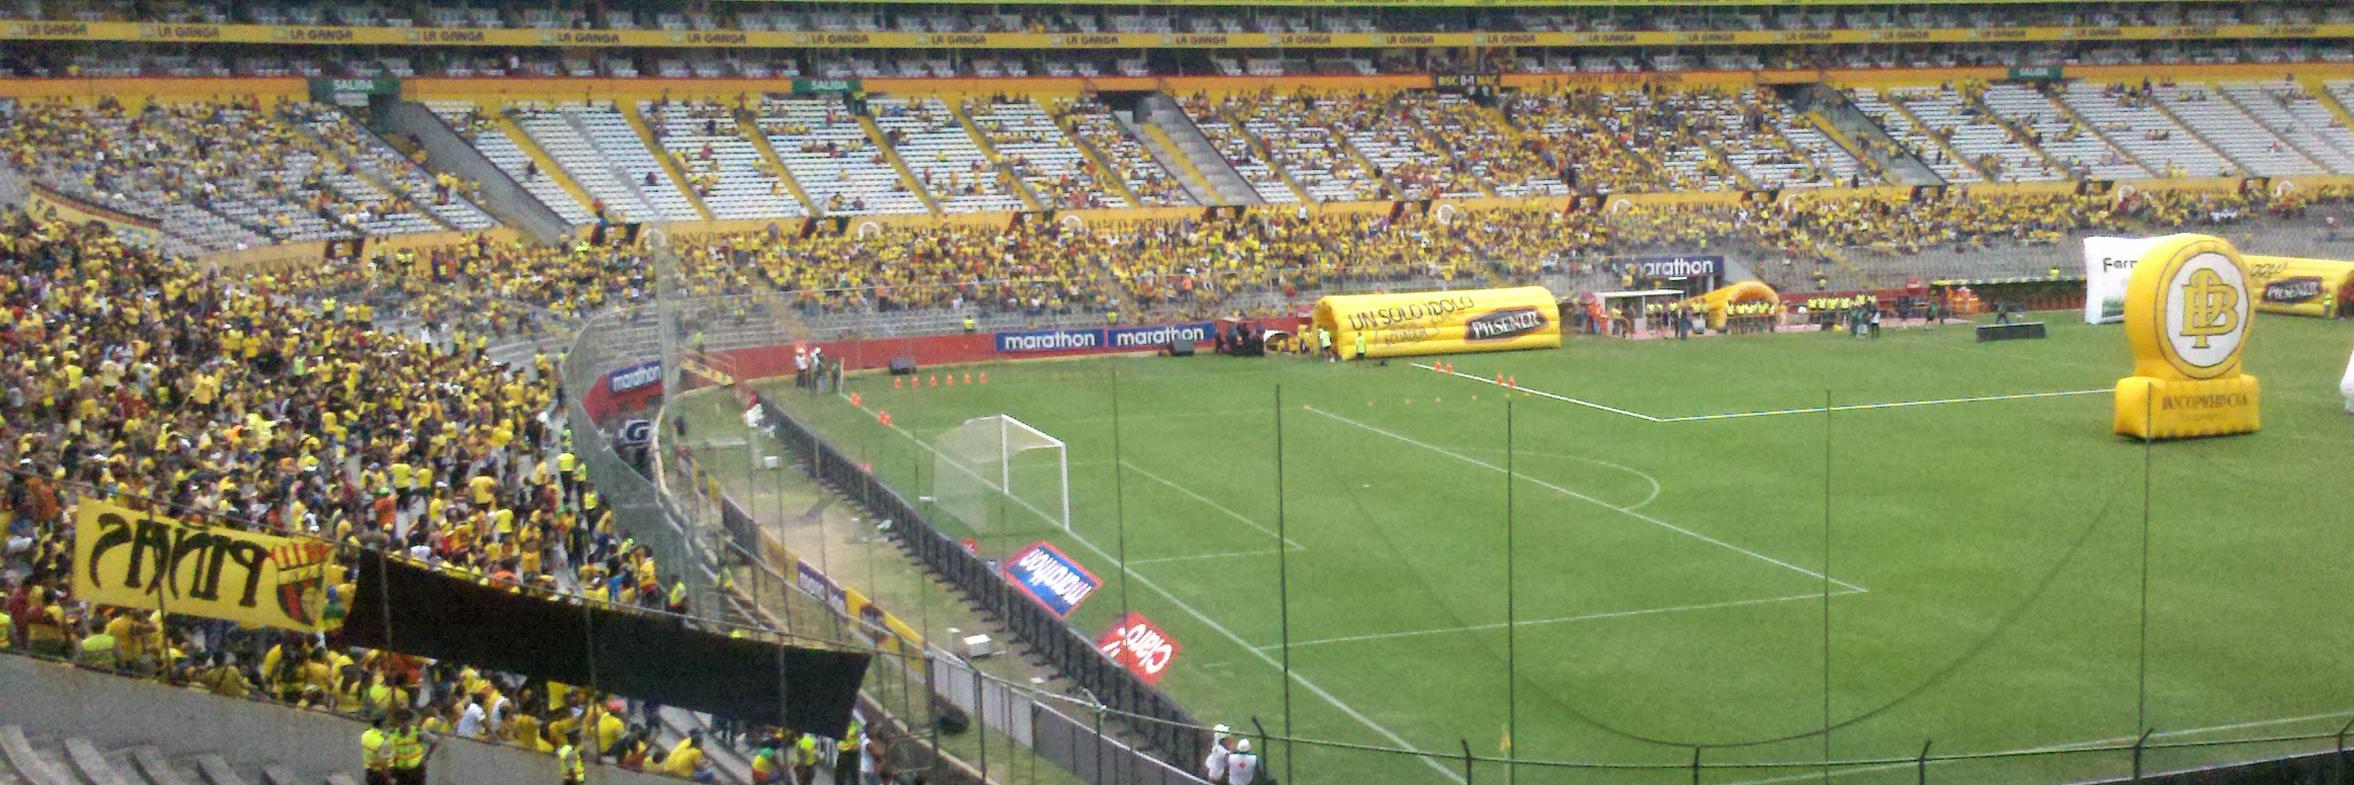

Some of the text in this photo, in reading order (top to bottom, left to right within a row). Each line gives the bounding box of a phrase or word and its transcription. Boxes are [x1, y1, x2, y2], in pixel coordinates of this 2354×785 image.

[26, 24, 88, 36] LA GANGA
[158, 26, 219, 38] LA GANGA
[290, 29, 352, 40] LA GANGA
[423, 31, 484, 42] LA GANGA
[558, 33, 619, 44] LA GANGA
[687, 34, 746, 44] LA GANGA
[812, 34, 869, 45] LA GANGA
[931, 35, 986, 45] LA GANGA
[1066, 35, 1118, 45] LA GANGA
[1176, 35, 1227, 45] LA GANGA
[1282, 35, 1331, 45] LA GANGA
[1386, 35, 1434, 45] LA GANGA
[1488, 34, 1535, 44] LA GANGA
[334, 80, 374, 90] SALIDA
[811, 79, 848, 90] SALIDA
[1625, 258, 1713, 276] arathon
[1349, 311, 1377, 331] UN
[1378, 304, 1423, 325] SOLO
[1472, 310, 1542, 338] PILSENER
[1005, 330, 1095, 350] marathon
[1117, 326, 1204, 346] marathon
[613, 366, 661, 392] marathon
[1019, 548, 1092, 606] marathon
[1124, 623, 1173, 675] Claro
